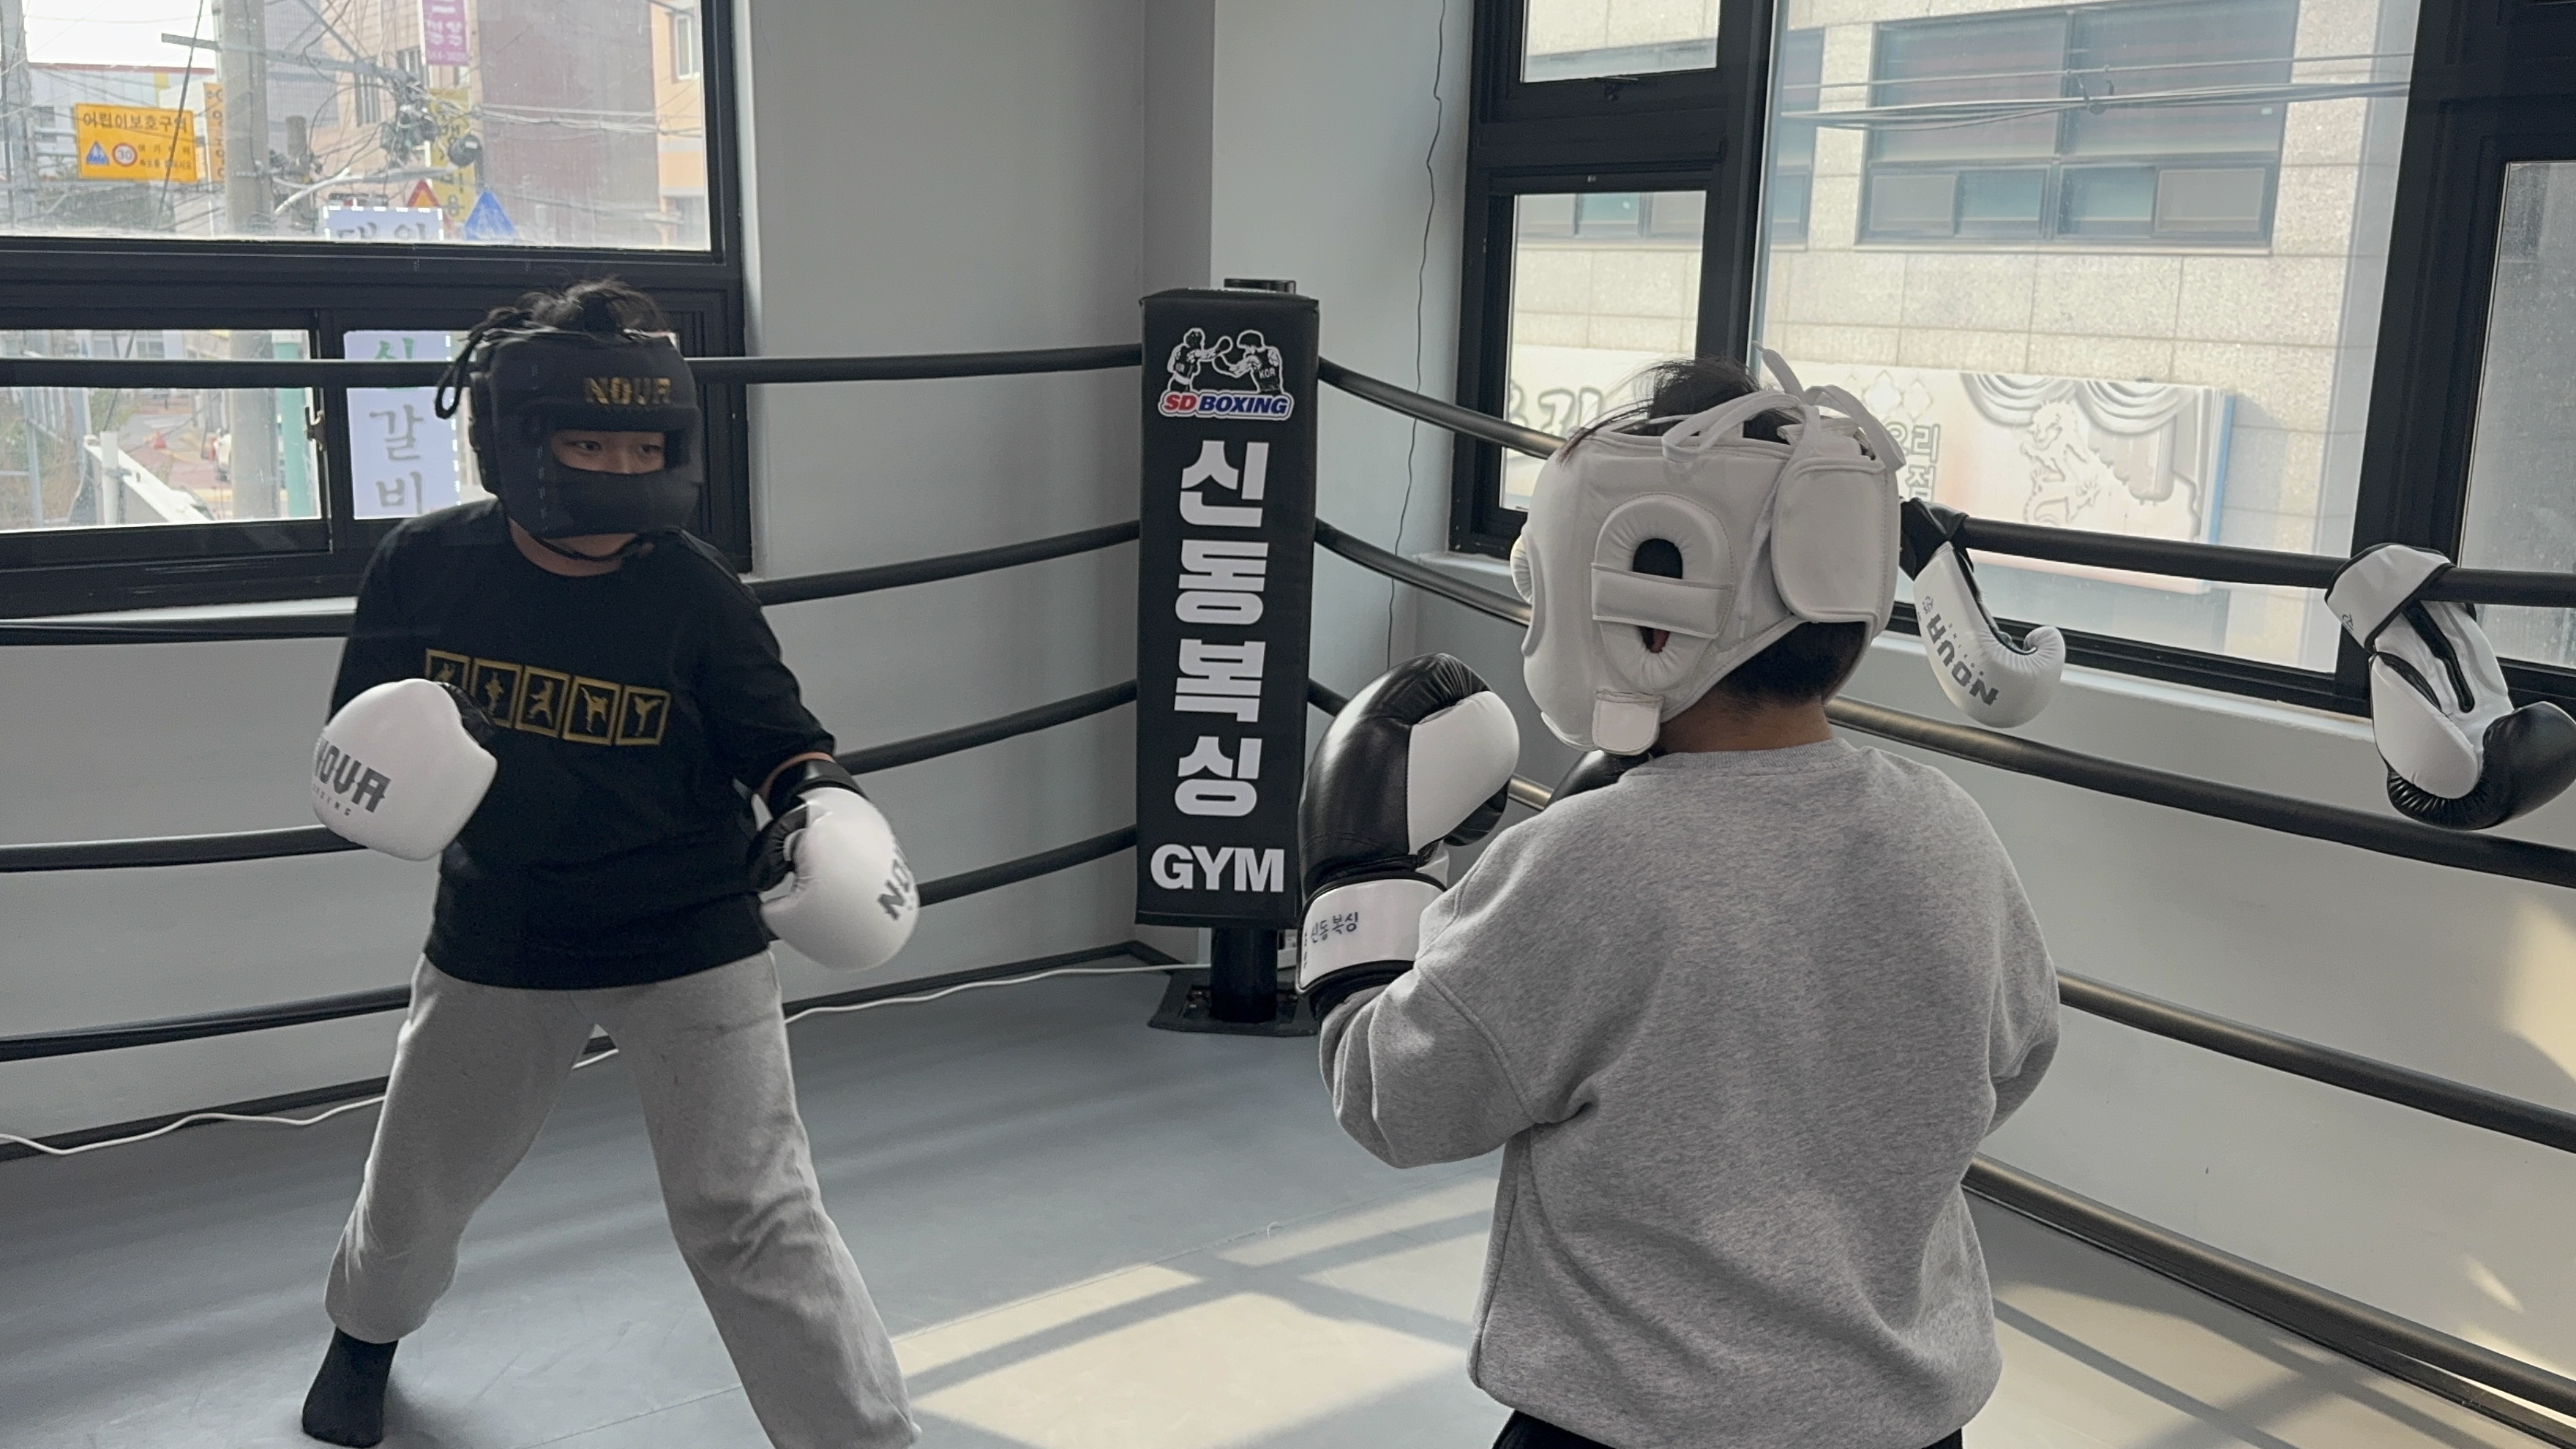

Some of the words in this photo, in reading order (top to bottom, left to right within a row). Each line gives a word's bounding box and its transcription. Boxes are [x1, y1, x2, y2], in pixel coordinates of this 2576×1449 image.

[116, 149, 132, 161] 30
[1199, 395, 1289, 414] BOXING
[1174, 439, 1270, 817] 신동복싱
[1150, 842, 1285, 893] GYM
